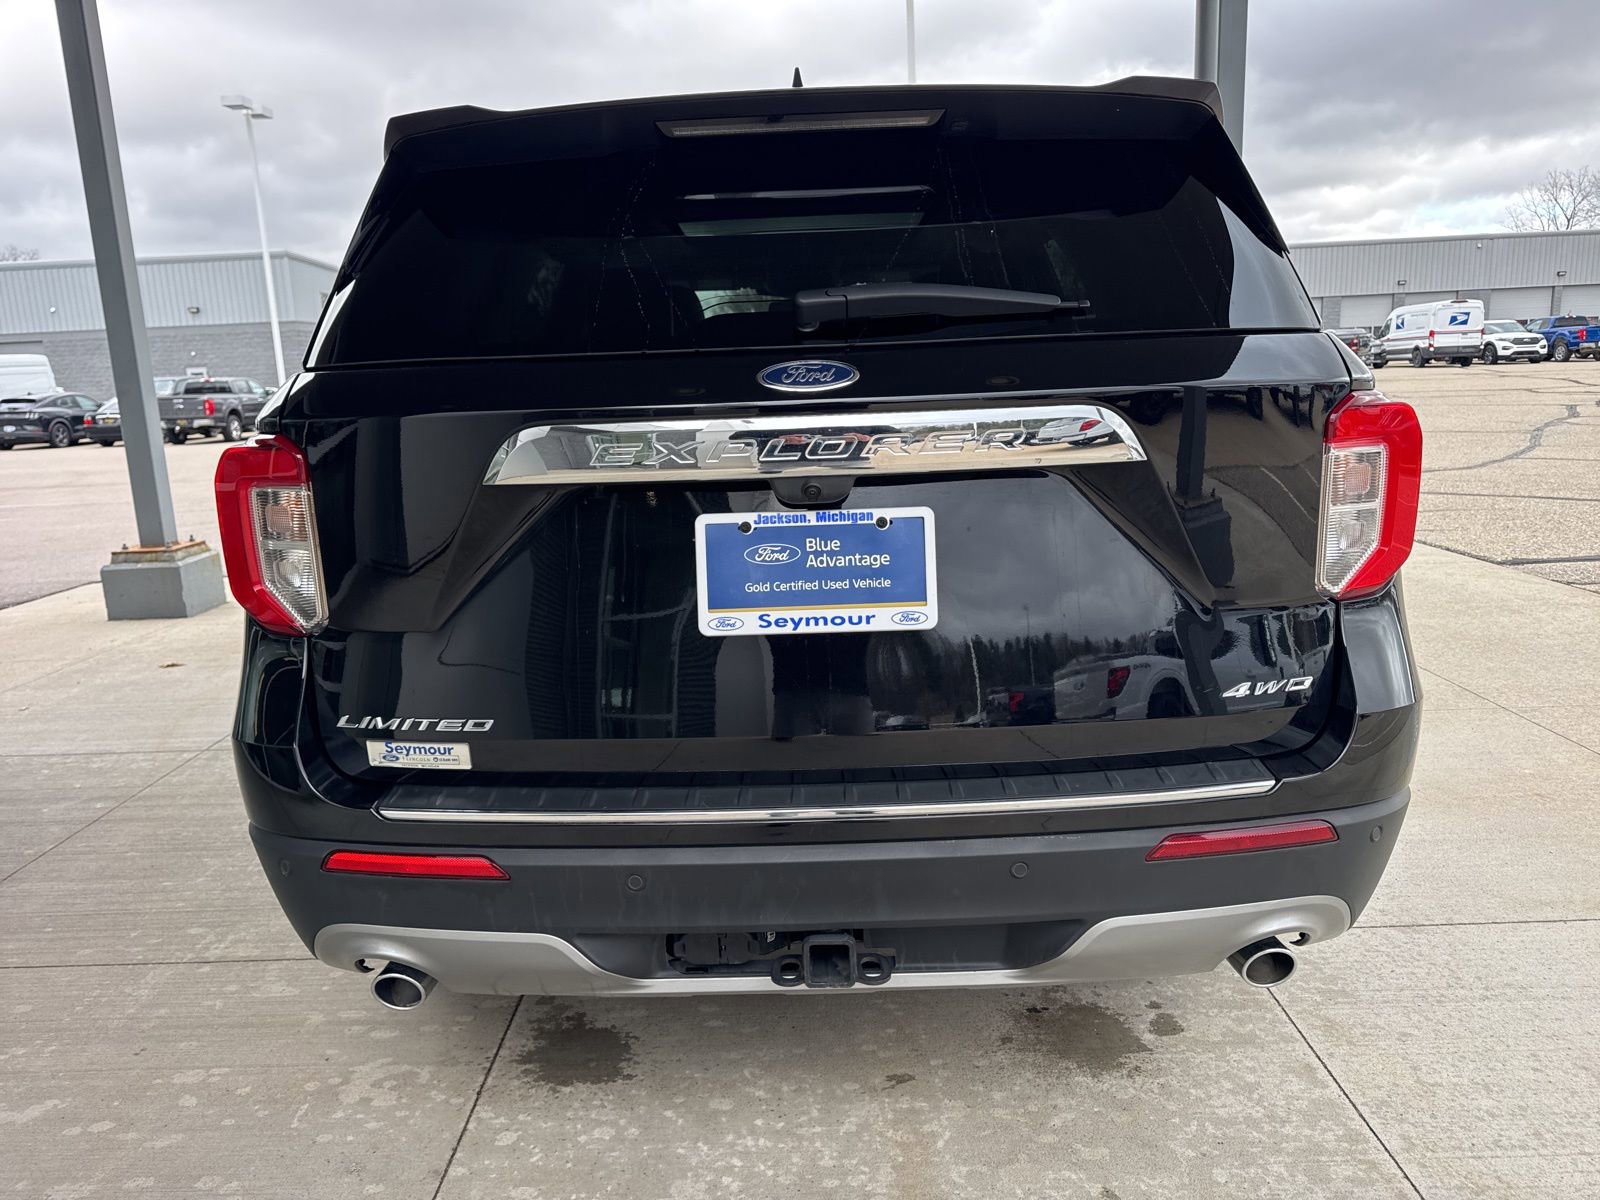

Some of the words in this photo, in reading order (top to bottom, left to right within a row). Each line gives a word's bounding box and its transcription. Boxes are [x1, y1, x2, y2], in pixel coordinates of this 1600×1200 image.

[781, 364, 836, 384] Ford
[589, 427, 1028, 467] EXPLORER
[753, 512, 811, 526] Jackson,
[815, 511, 874, 524] Michigan
[805, 537, 841, 551] Blue
[754, 545, 790, 563] Ford
[805, 553, 891, 569] Advantage
[744, 581, 770, 593] Gold
[773, 579, 819, 592] Certified
[822, 578, 849, 590] Used
[853, 577, 891, 589] Vehicle
[714, 617, 737, 630] Ford
[758, 613, 876, 632] Seymour
[898, 612, 921, 624] Ford
[1222, 676, 1313, 698] 4WD
[336, 715, 495, 732] LIMITED
[384, 741, 454, 757] Seymour
